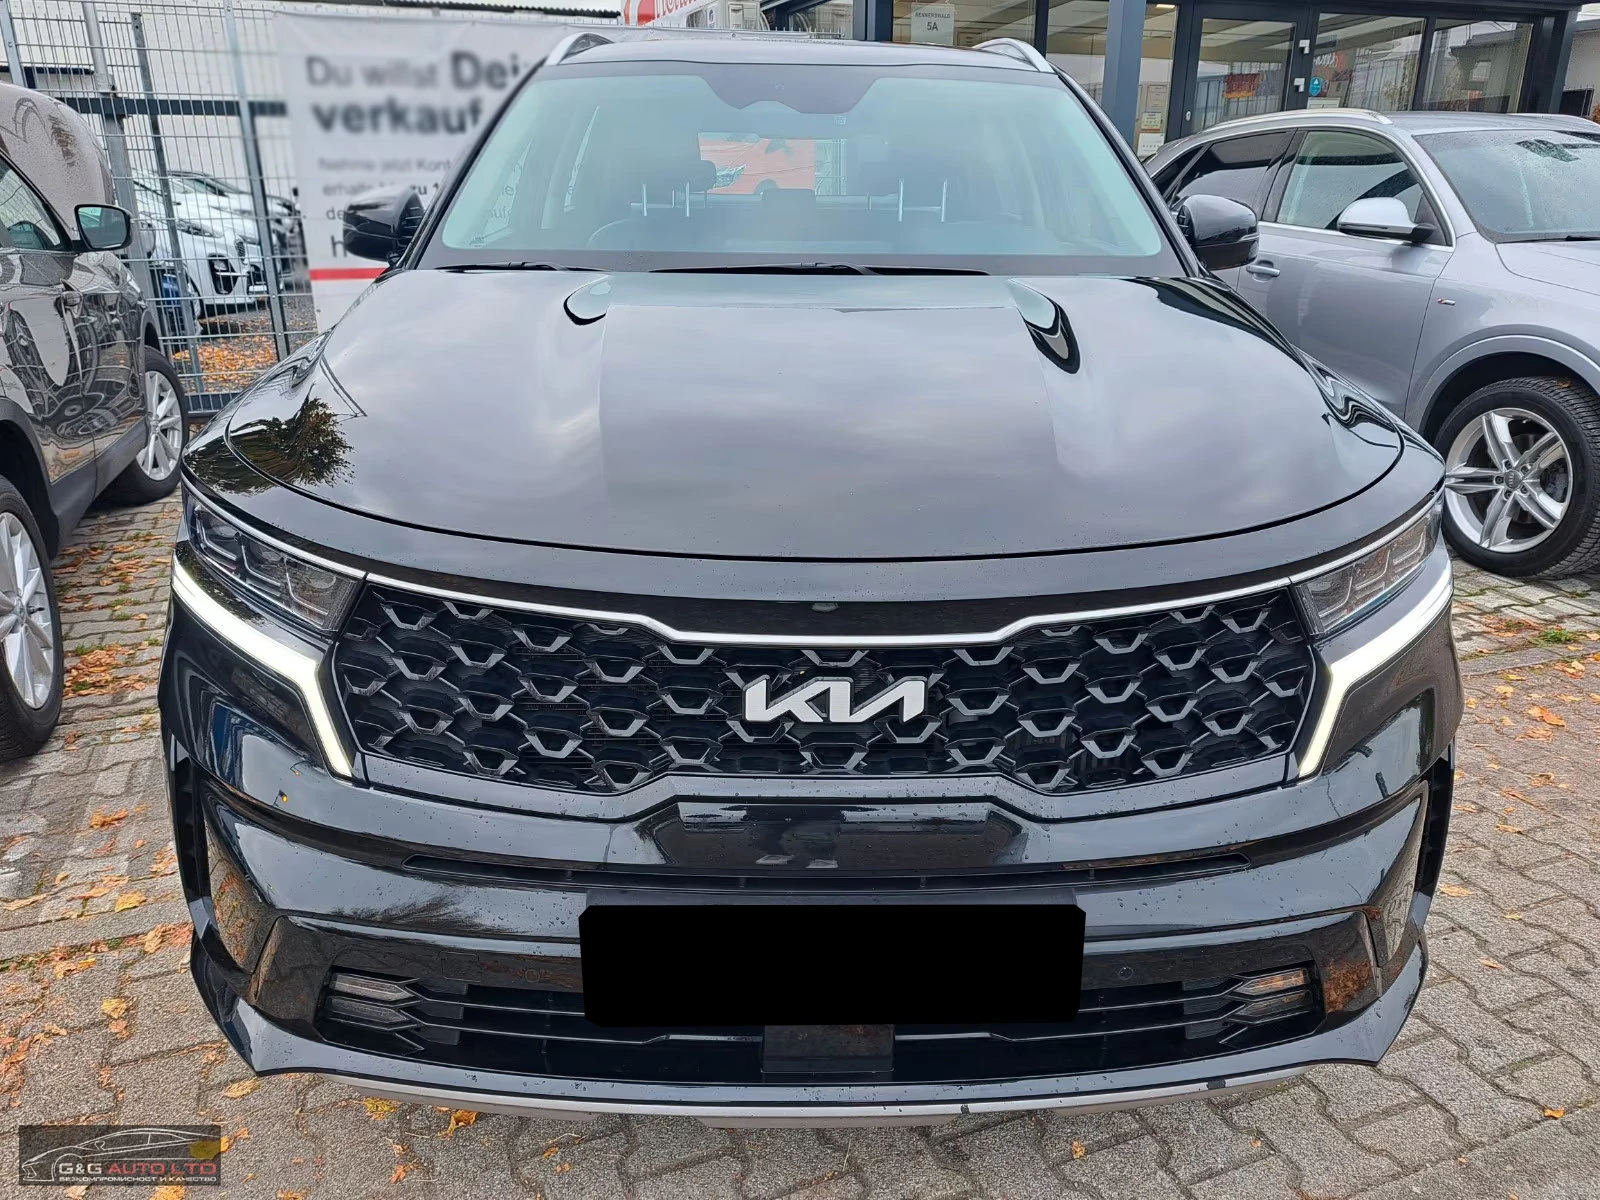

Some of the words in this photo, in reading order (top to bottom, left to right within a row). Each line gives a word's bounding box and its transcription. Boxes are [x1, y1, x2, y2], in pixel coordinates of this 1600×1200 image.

[926, 21, 939, 31] 5A
[306, 55, 353, 87] Du
[451, 50, 530, 90] Dei
[744, 676, 926, 723] KIA
